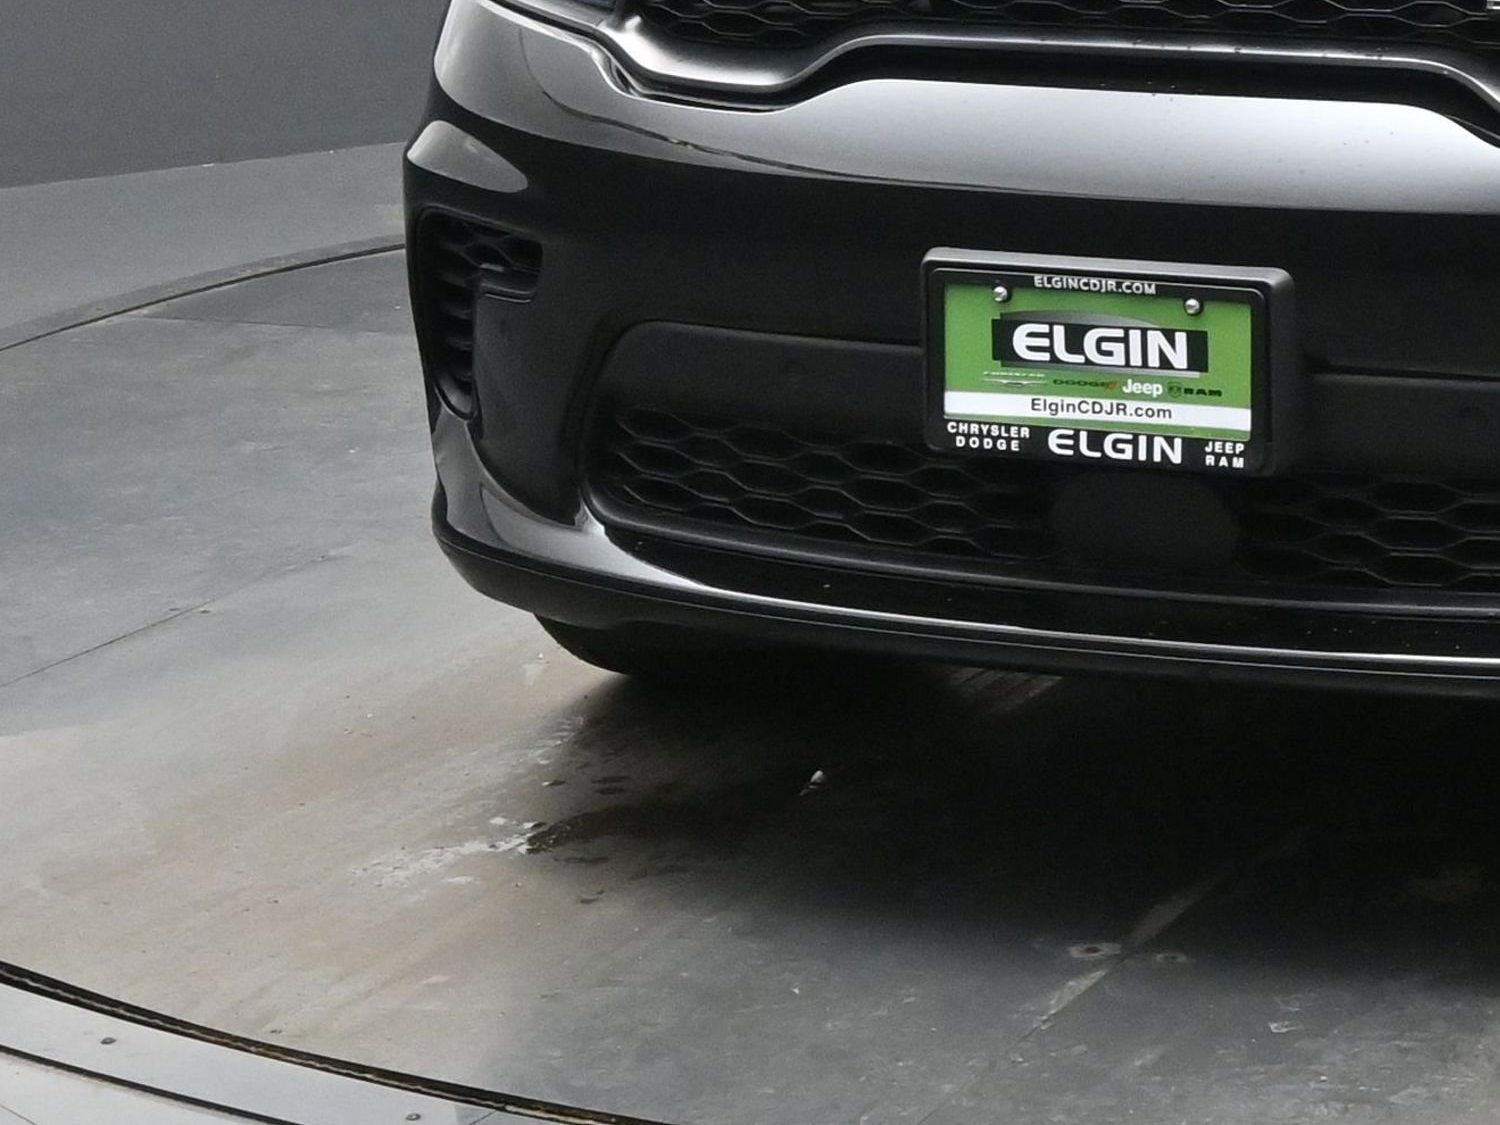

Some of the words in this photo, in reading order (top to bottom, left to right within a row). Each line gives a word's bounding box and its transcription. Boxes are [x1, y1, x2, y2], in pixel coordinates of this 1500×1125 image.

[1034, 275, 1156, 295] ELGINCDJR.COM
[1012, 323, 1188, 369] ELGIN
[1122, 378, 1163, 398] Jeep
[1031, 398, 1172, 419] ElginCDJR.com
[947, 421, 1030, 439] CHRYSLER
[955, 436, 1020, 451] DODGE
[1048, 428, 1183, 464] ELGIN
[1204, 441, 1245, 455] JEEP
[1205, 455, 1245, 468] RAM
